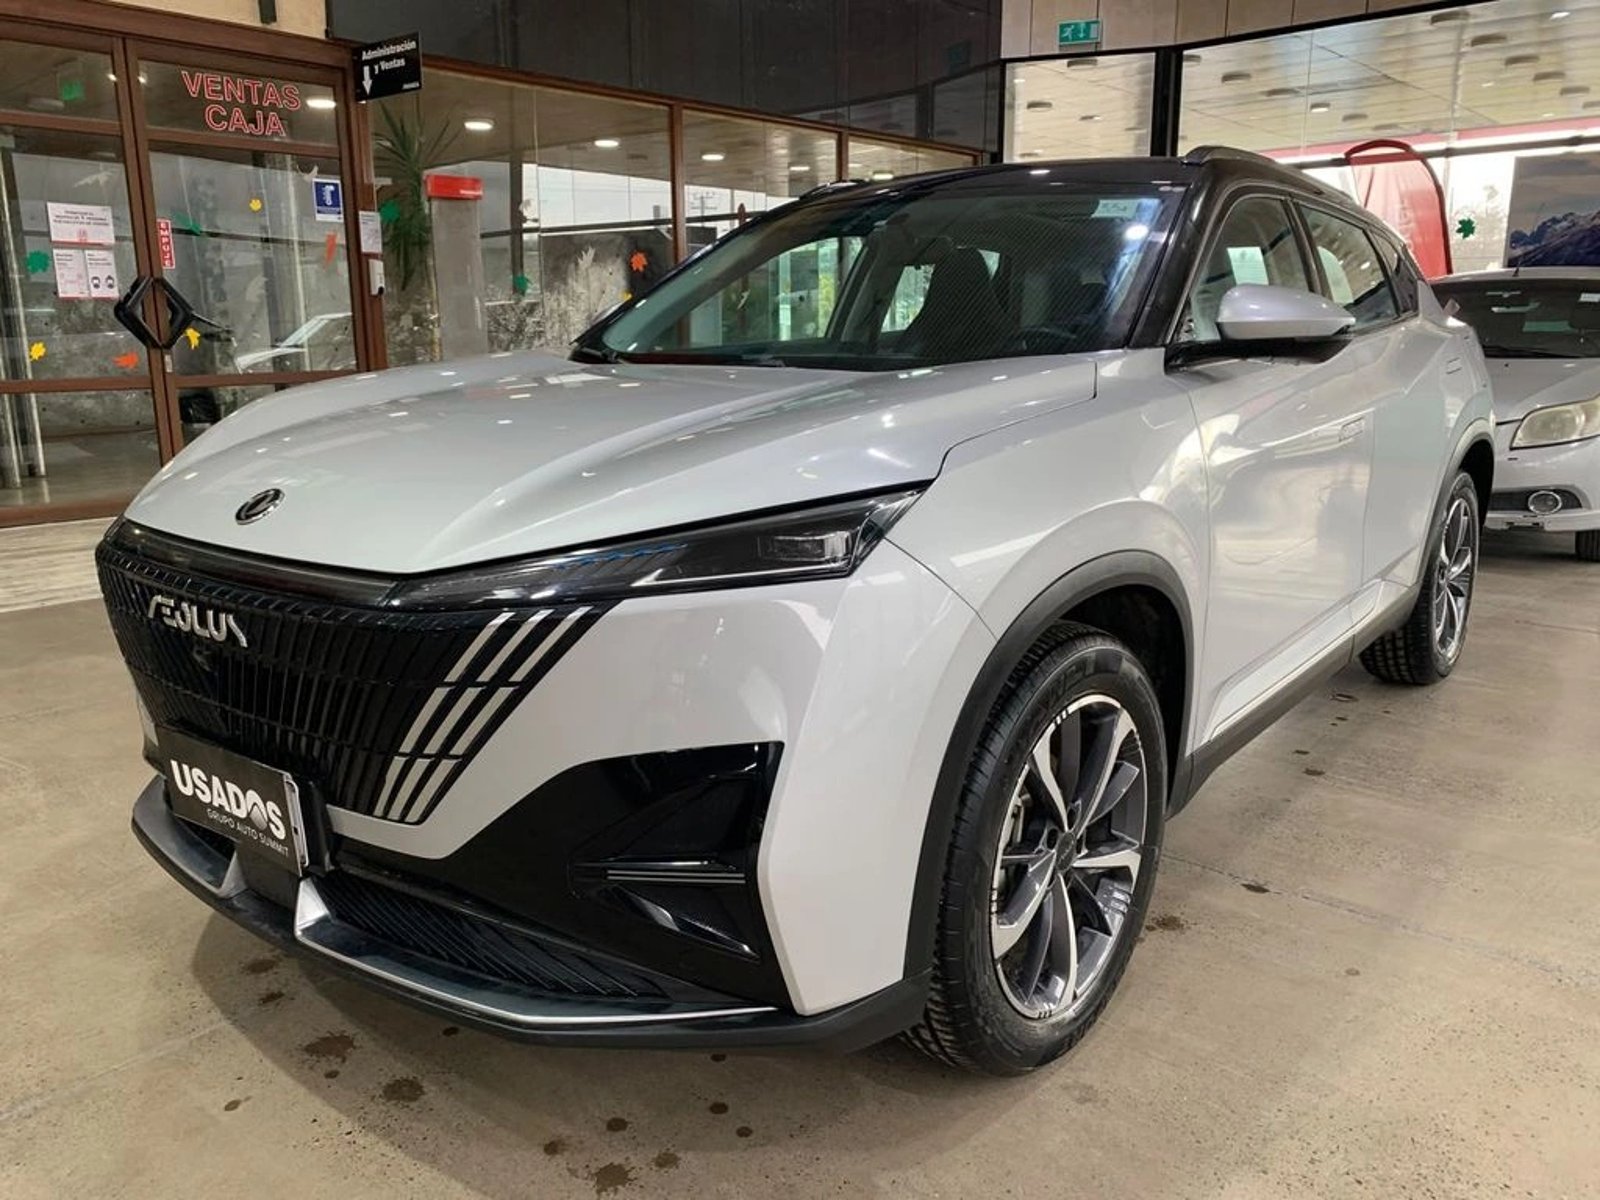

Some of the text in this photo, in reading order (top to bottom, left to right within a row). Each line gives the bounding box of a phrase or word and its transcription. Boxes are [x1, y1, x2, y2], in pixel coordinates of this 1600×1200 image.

[380, 58, 406, 71] Ventas
[180, 69, 301, 112] VENTAS
[204, 103, 287, 137] CAJA
[169, 758, 287, 840] USADOS
[206, 807, 236, 829] GRUPO
[236, 821, 259, 841] AUTO
